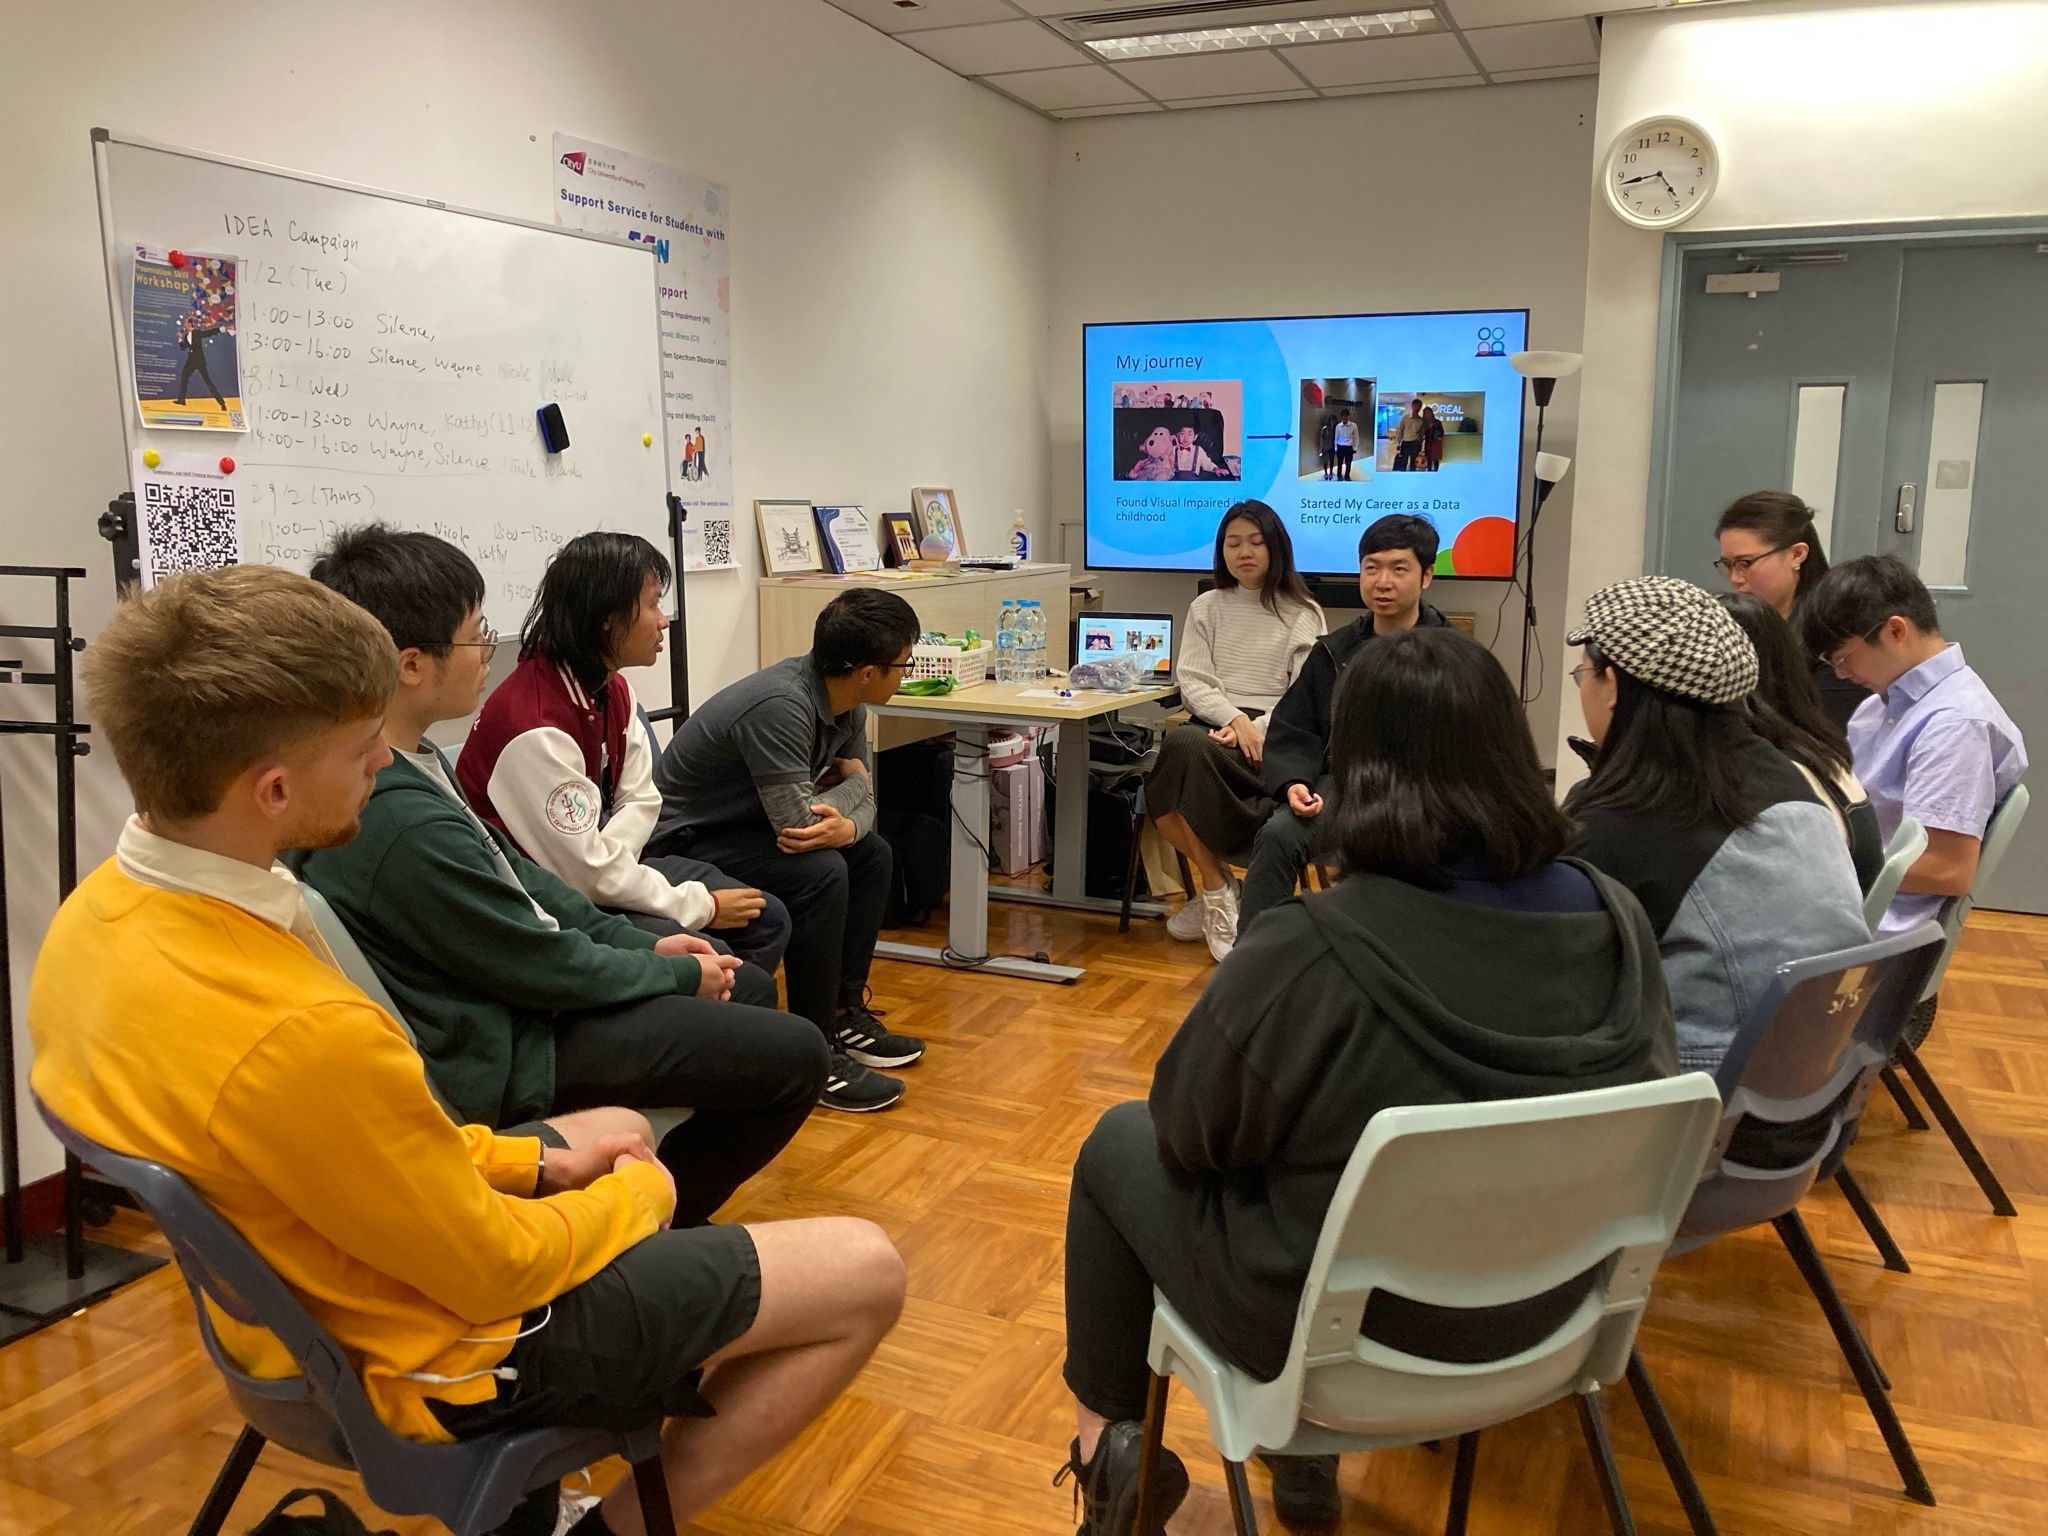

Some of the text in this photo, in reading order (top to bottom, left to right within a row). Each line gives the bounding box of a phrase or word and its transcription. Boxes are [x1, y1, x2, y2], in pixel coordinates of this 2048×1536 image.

[1656, 131, 1670, 143] 12
[1679, 136, 1684, 146] 1
[1639, 138, 1650, 149] 11
[1691, 147, 1699, 158] 2
[1624, 153, 1637, 164] 10
[1618, 171, 1625, 181] 9
[1696, 167, 1704, 177] 3
[1622, 189, 1630, 199] 8
[1688, 186, 1696, 196] 4
[1635, 201, 1642, 211] 7
[1654, 206, 1661, 215] 6
[1674, 200, 1681, 211] 5
[560, 188, 725, 241] Support Service for Students with
[224, 213, 359, 262] IDEA Campaign
[135, 272, 190, 293] Workshop
[434, 357, 484, 379] Wayne
[1116, 354, 1203, 372] My journey
[1116, 497, 1148, 508] Found
[1150, 497, 1181, 508] Visual
[1183, 497, 1230, 510] Impaired
[1300, 498, 1460, 511] Started My Career as a Data
[1116, 511, 1166, 522] childhood
[1300, 513, 1361, 526] Entry Clerk
